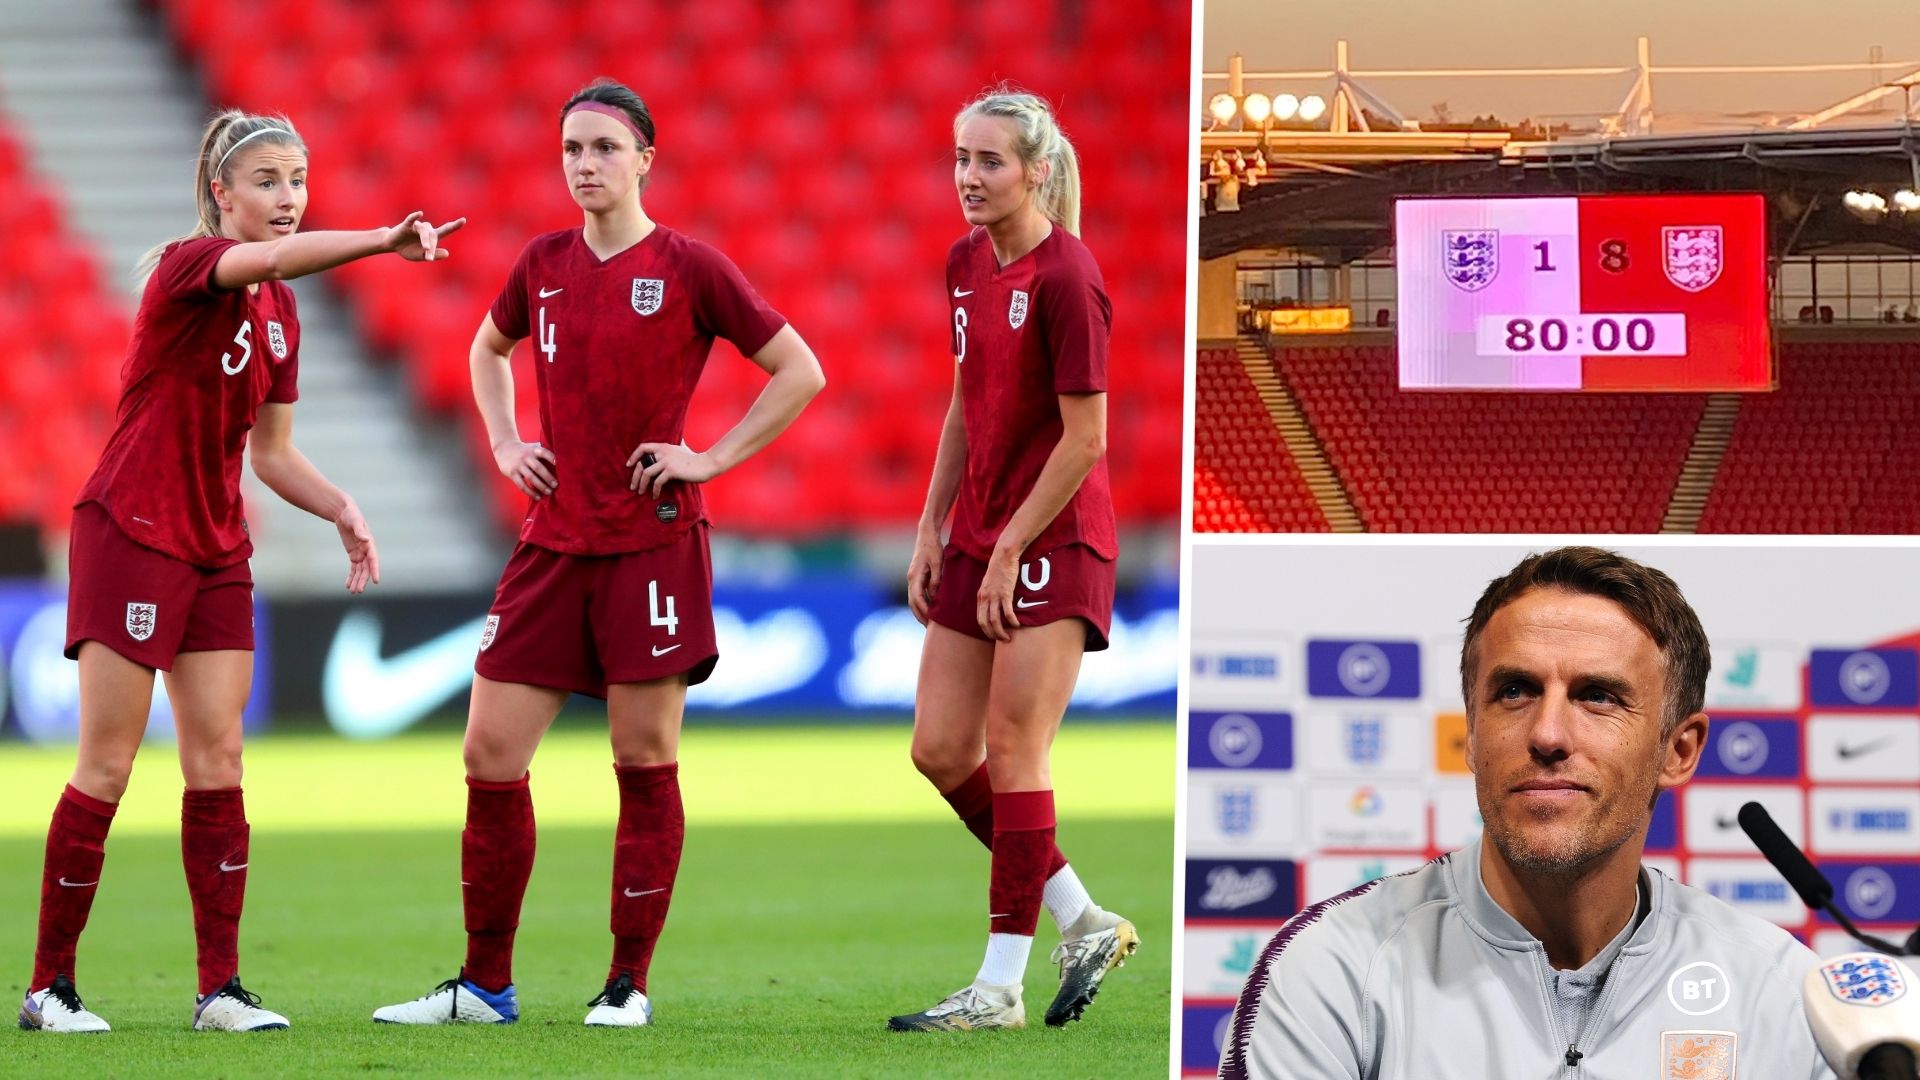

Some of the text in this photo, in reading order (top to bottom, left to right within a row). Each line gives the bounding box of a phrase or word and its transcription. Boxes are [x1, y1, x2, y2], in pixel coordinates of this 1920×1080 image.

[1533, 238, 1631, 275] 1 8
[221, 319, 252, 375] 5
[539, 306, 557, 363] 4
[954, 306, 968, 364] 6
[1505, 318, 1655, 351] 80:00
[648, 580, 679, 636] 4
[1682, 978, 1717, 1000] BT
